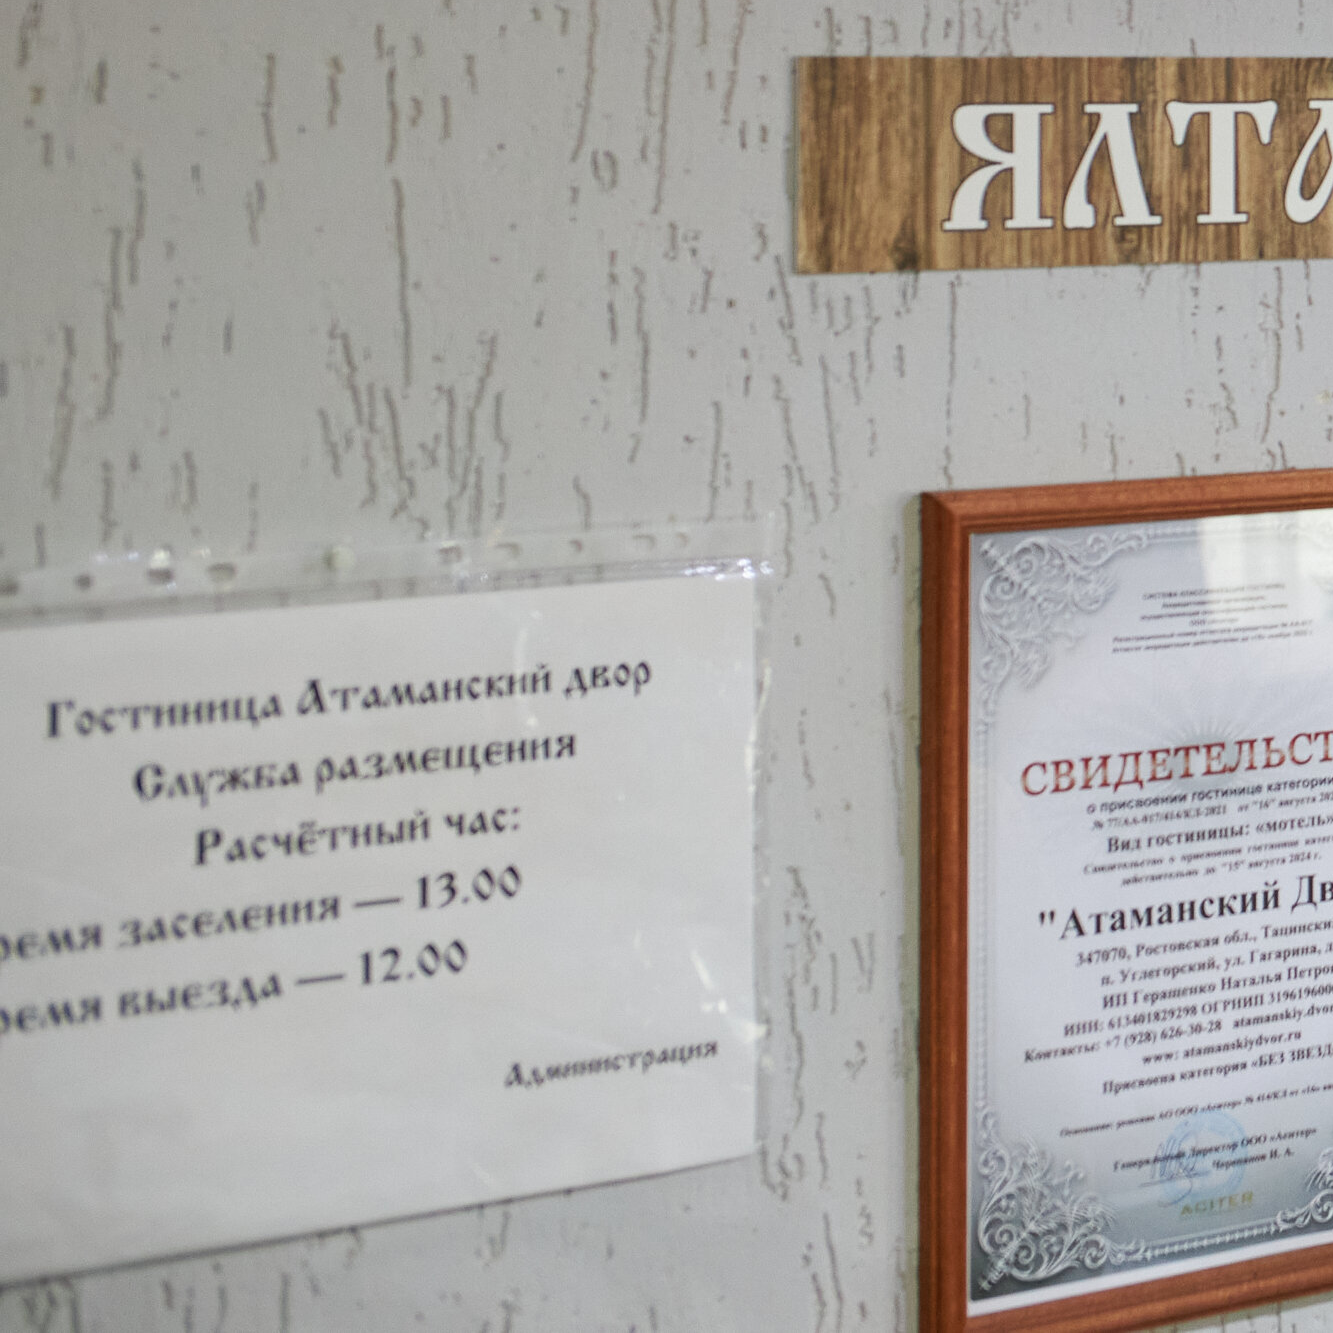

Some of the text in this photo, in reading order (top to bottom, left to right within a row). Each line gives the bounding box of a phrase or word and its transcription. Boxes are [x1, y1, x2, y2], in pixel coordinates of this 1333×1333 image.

[47, 661, 652, 738] Гостиница Атаманский двор
[133, 733, 577, 808] Служба размещения
[194, 806, 521, 867] Расчётный час:
[1107, 834, 1141, 854] Вид
[1147, 823, 1251, 848] гостиницы:
[119, 896, 341, 948] заселения
[416, 864, 522, 910] 13.00
[1038, 880, 1280, 941] "Атаманский
[117, 973, 282, 1019] выезда
[359, 939, 468, 985] 12.00
[1221, 971, 1282, 991] Наталья
[504, 1040, 718, 1088] Администрация
